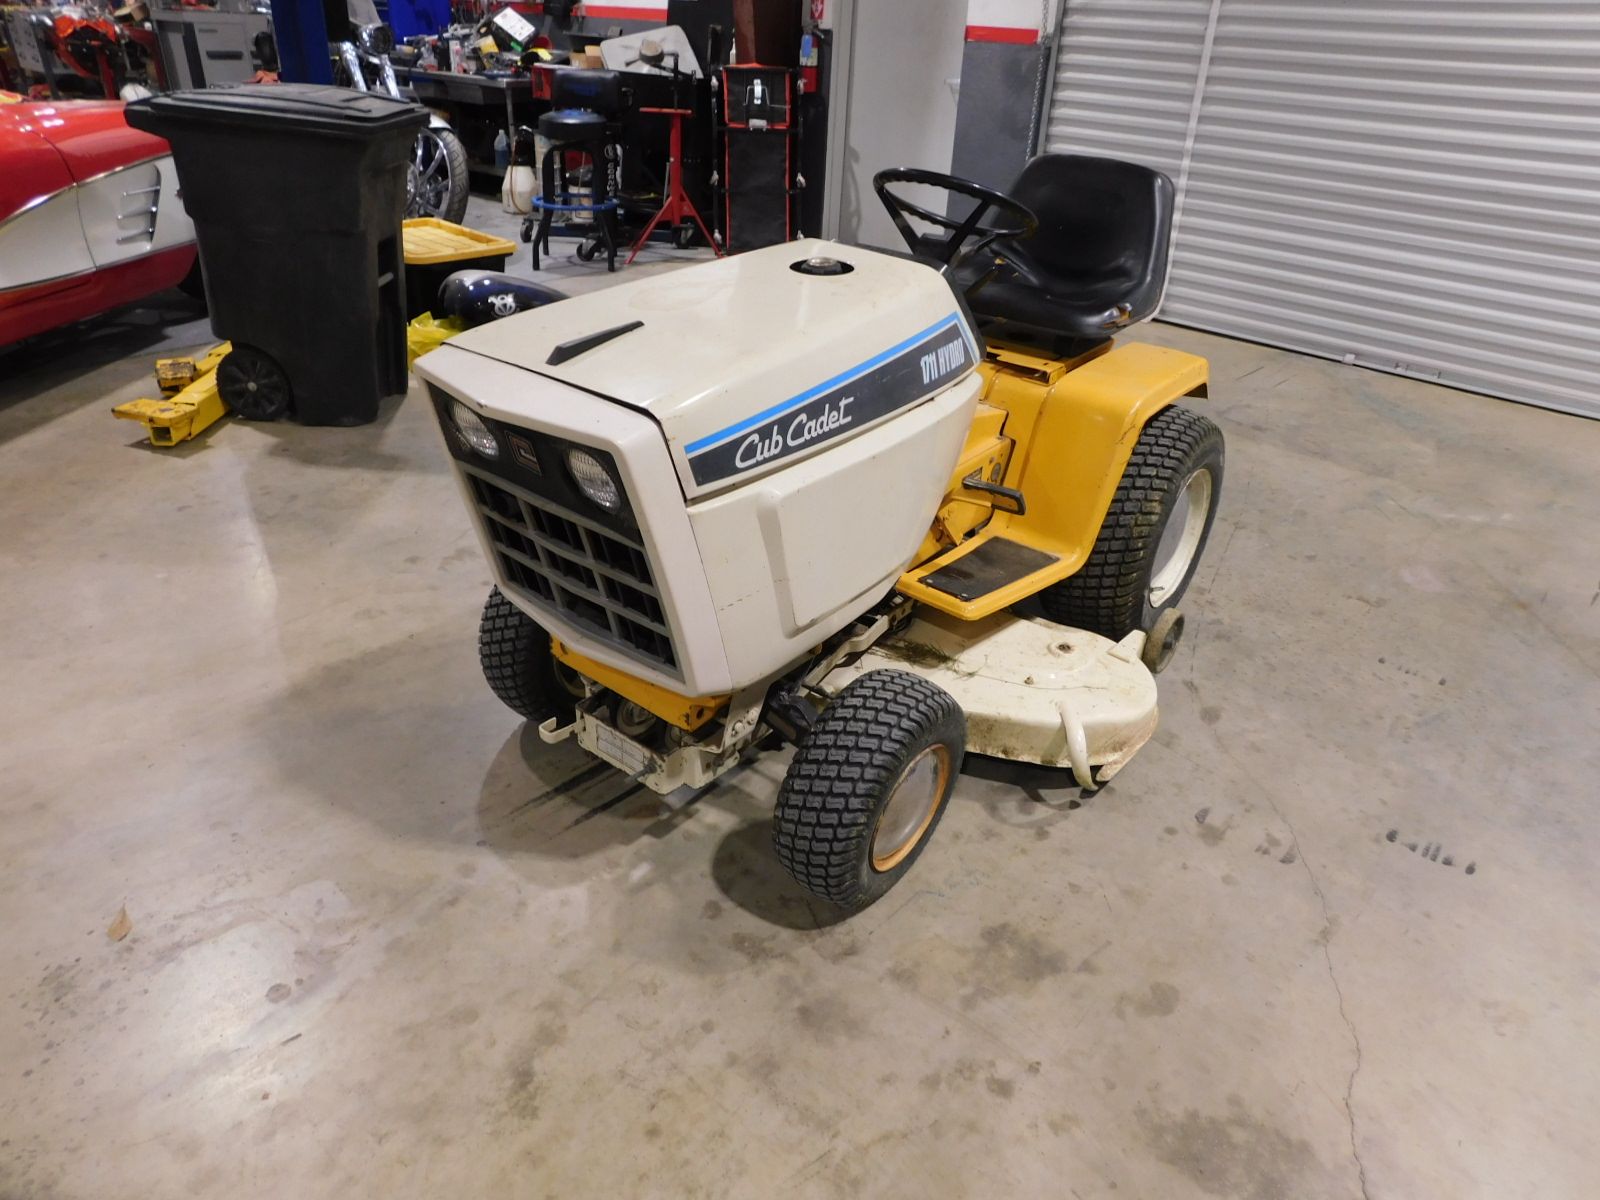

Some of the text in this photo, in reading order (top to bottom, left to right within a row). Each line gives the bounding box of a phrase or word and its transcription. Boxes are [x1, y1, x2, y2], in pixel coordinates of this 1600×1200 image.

[920, 337, 964, 385] 1711 HYDRO
[735, 396, 854, 468] Cub Cadet
